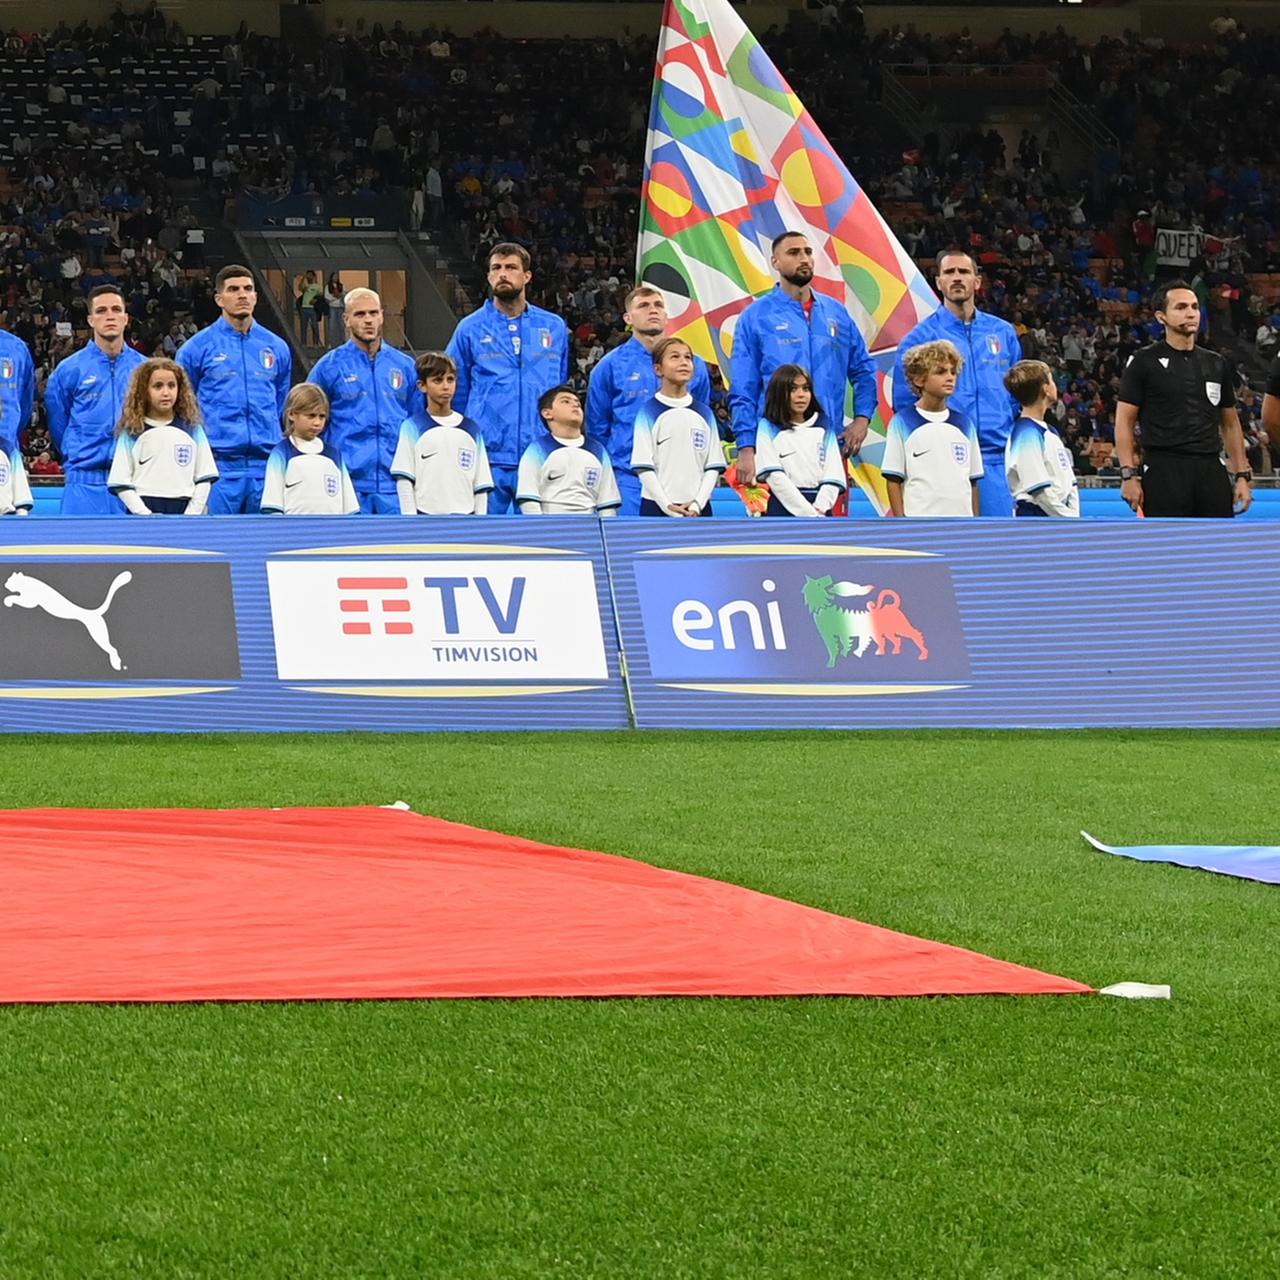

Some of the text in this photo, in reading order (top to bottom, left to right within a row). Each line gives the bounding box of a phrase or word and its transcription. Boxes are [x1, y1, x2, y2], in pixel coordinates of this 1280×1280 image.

[424, 577, 526, 634] TV
[672, 579, 786, 650] eni
[433, 647, 538, 662] TIMVISION
